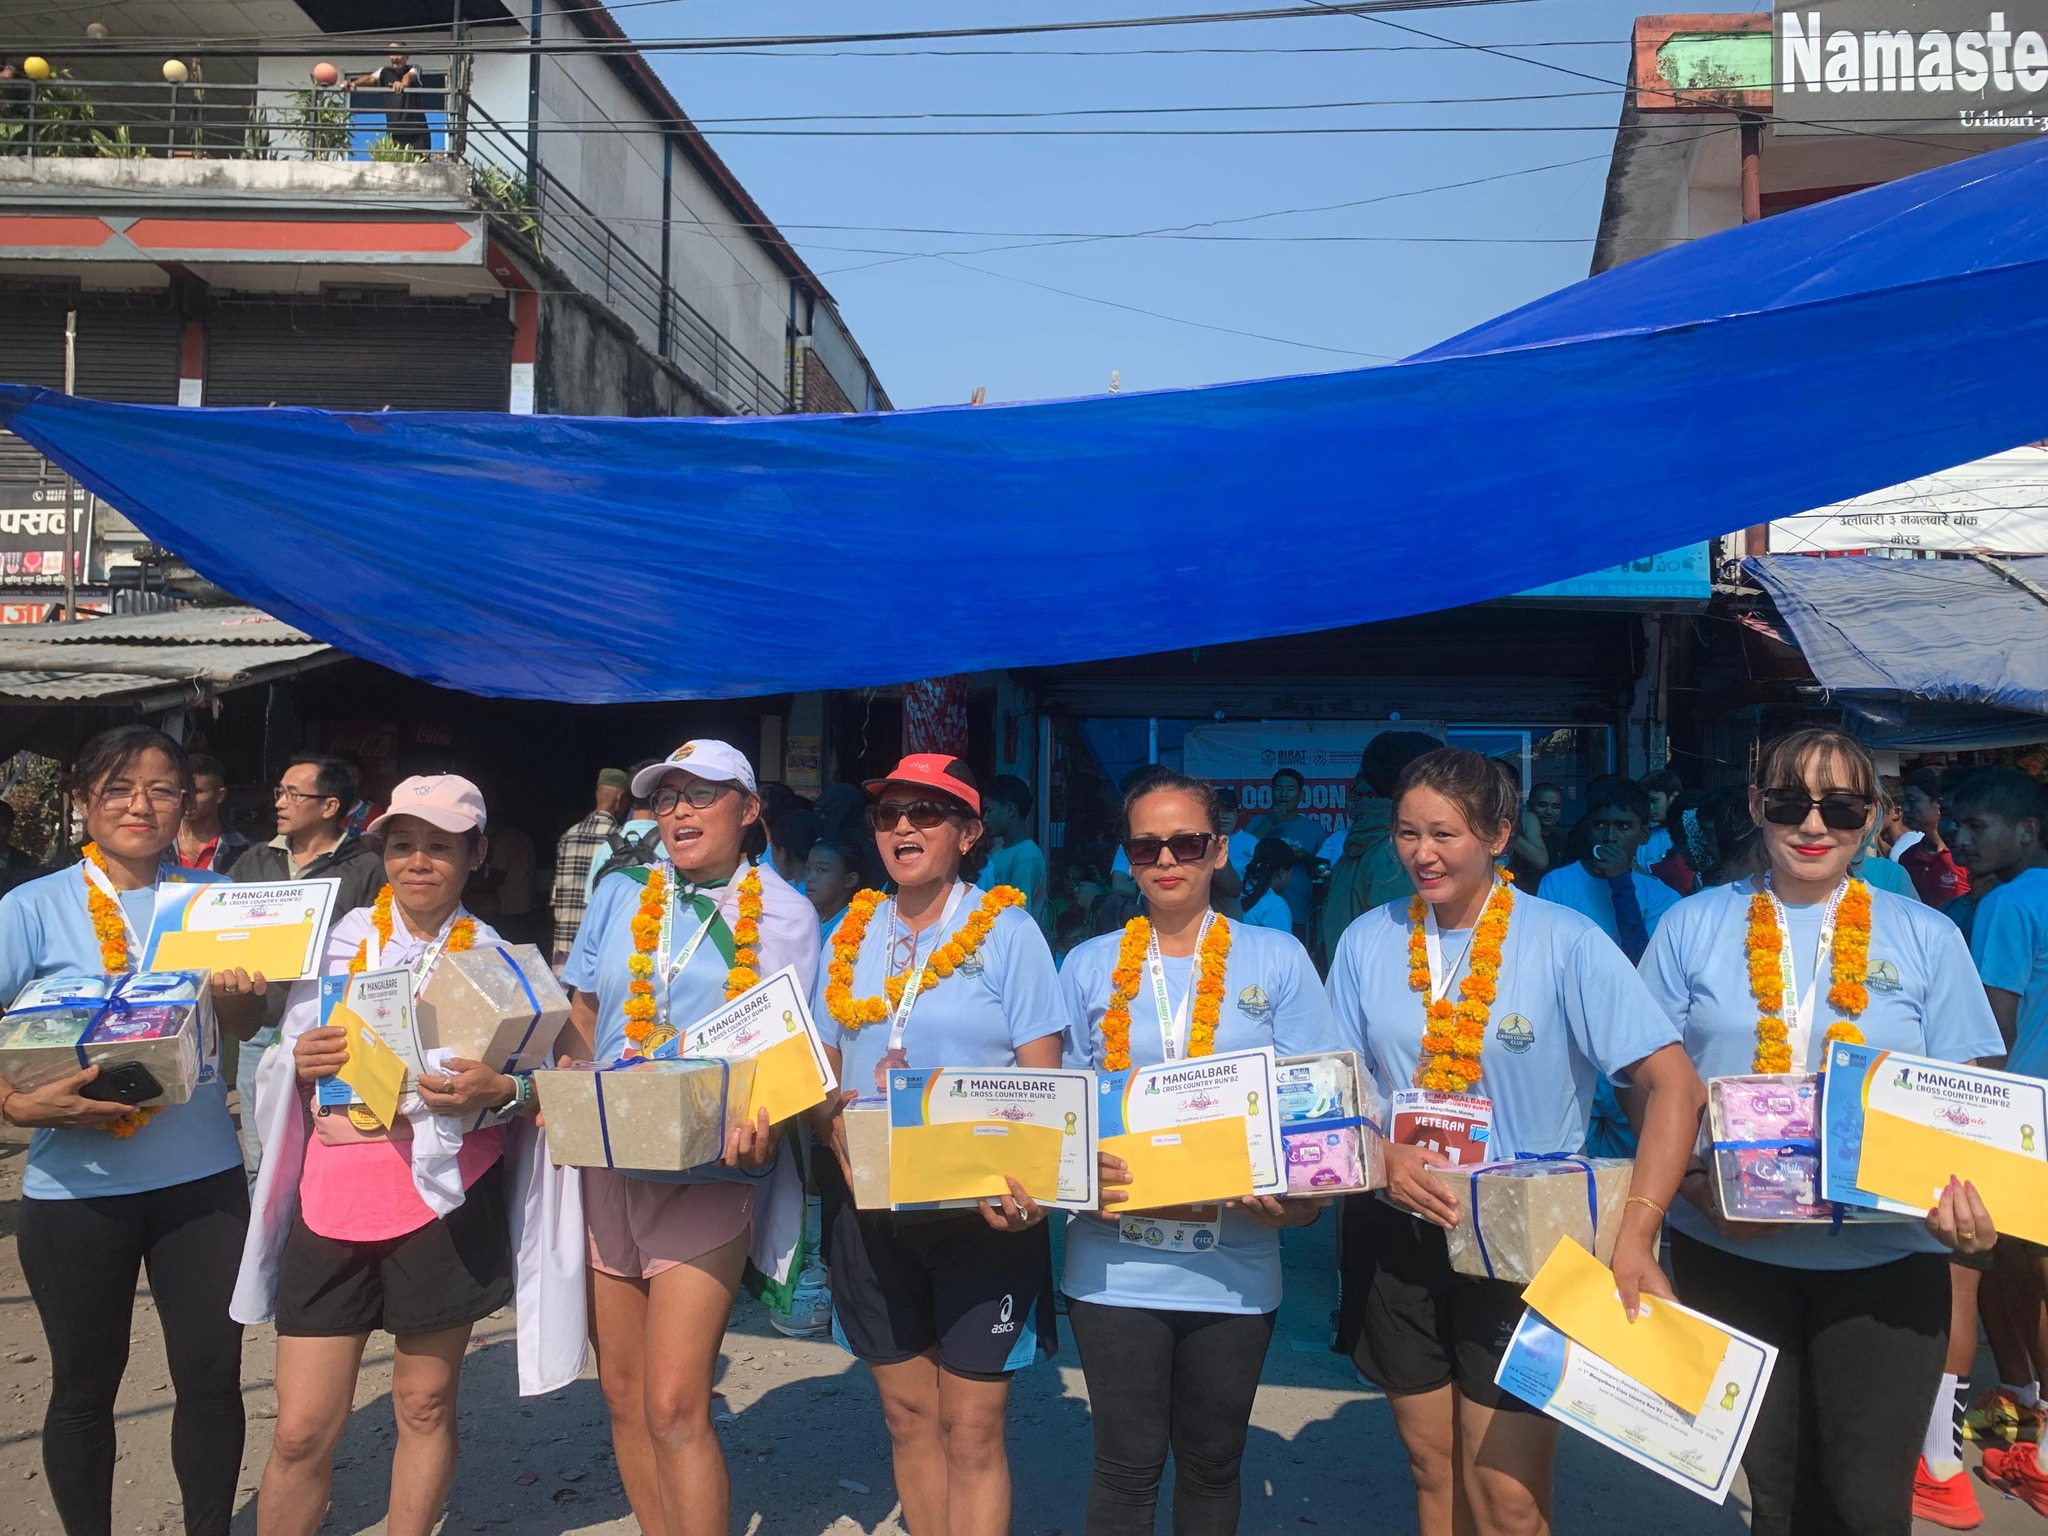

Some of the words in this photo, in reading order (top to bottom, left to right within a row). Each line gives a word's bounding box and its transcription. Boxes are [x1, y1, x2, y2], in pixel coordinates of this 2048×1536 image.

[1782, 11, 2048, 94] Namaste
[1277, 750, 1308, 758] BIRAT
[231, 888, 304, 900] MANGALBARE
[366, 978, 398, 992] MANGALBARE
[1784, 964, 1793, 992] Country
[1155, 978, 1165, 997] Cross
[904, 989, 916, 1008] Club
[1785, 990, 1796, 1007] Club
[708, 992, 770, 1037] MANGALBARE
[1158, 995, 1170, 1023] Country
[710, 1030, 728, 1043] CROSS
[727, 1015, 752, 1034] COUNTRY
[1163, 1020, 1173, 1038] Club
[1162, 1064, 1238, 1085] MANGALBARE
[970, 1080, 1056, 1092] MANGALBARE
[1162, 1083, 1182, 1093] CROSS
[1183, 1080, 1213, 1090] COUNTRY
[1214, 1075, 1239, 1085] RUN'82
[1917, 1071, 2011, 1100] MANGALBARE
[994, 1091, 1028, 1099] COUNTRY
[1029, 1092, 1056, 1100] RUN'82
[1434, 1093, 1492, 1107] MANGALBARE
[1916, 1085, 1941, 1096] CROSS
[1942, 1089, 1979, 1103] COUNTRY
[1414, 1116, 1465, 1133] VETERAN
[991, 1322, 1014, 1334] asics
